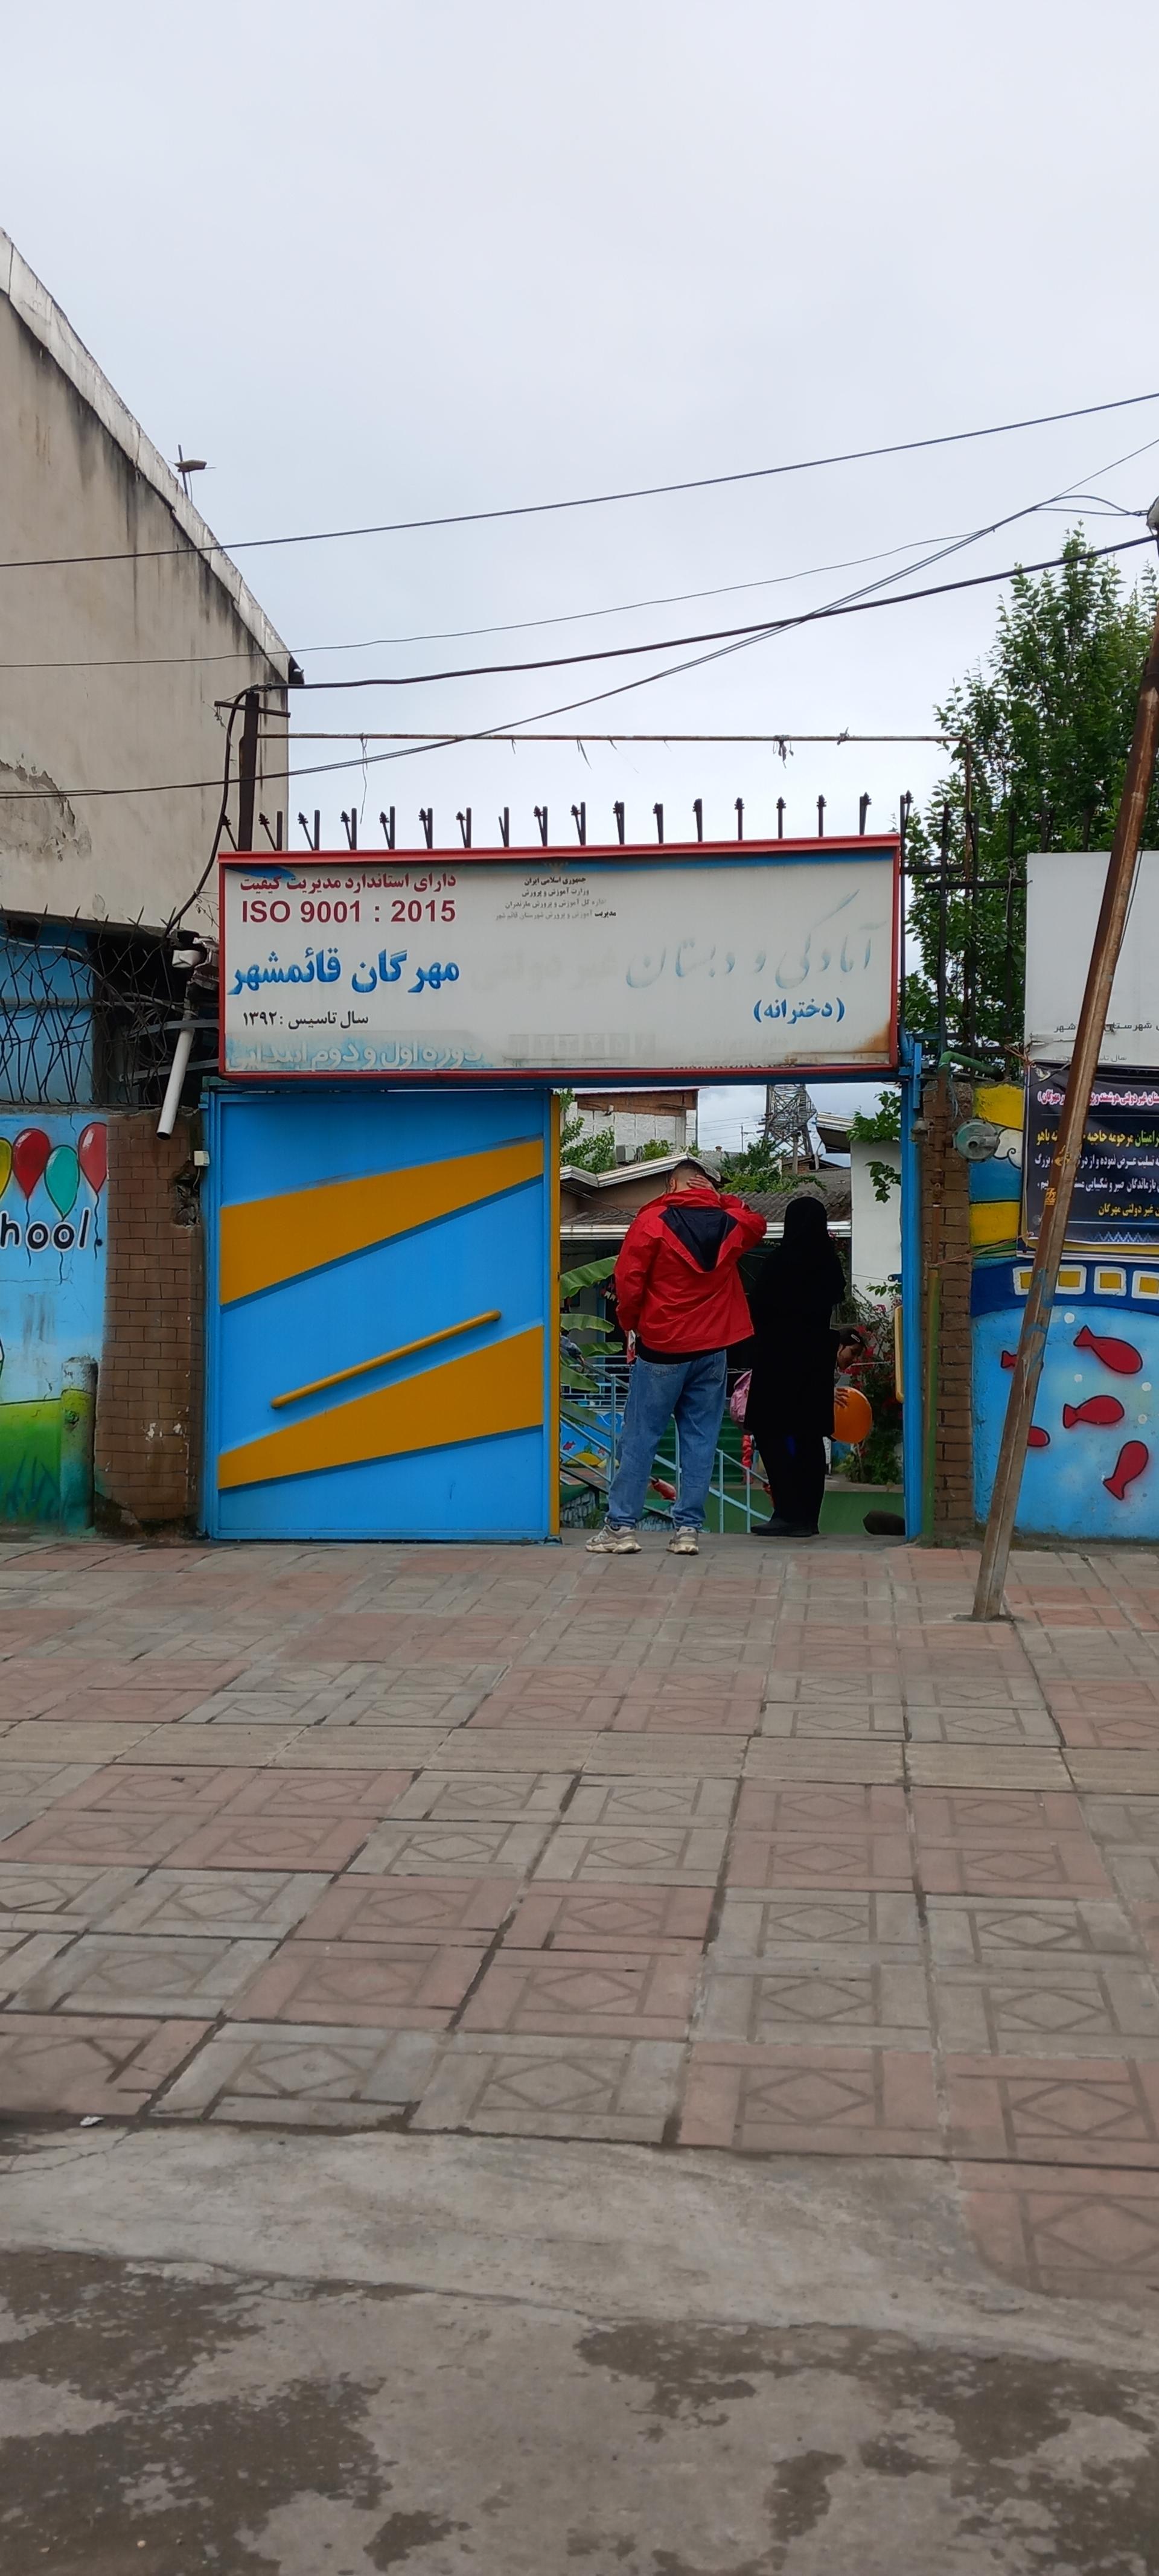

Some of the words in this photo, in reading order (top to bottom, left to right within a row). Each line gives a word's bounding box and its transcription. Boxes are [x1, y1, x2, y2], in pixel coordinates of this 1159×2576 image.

[286, 877, 342, 895] مدیریت
[345, 873, 410, 895] استاندارد
[413, 872, 457, 893] دارای
[524, 877, 540, 886] ایران
[541, 877, 561, 886] اسلامی
[548, 887, 570, 897] آموزش
[242, 901, 291, 924] ISO
[301, 900, 362, 924] 9001
[391, 899, 457, 922] 2015
[351, 948, 460, 994] مهرگان
[339, 1011, 369, 1029] سال
